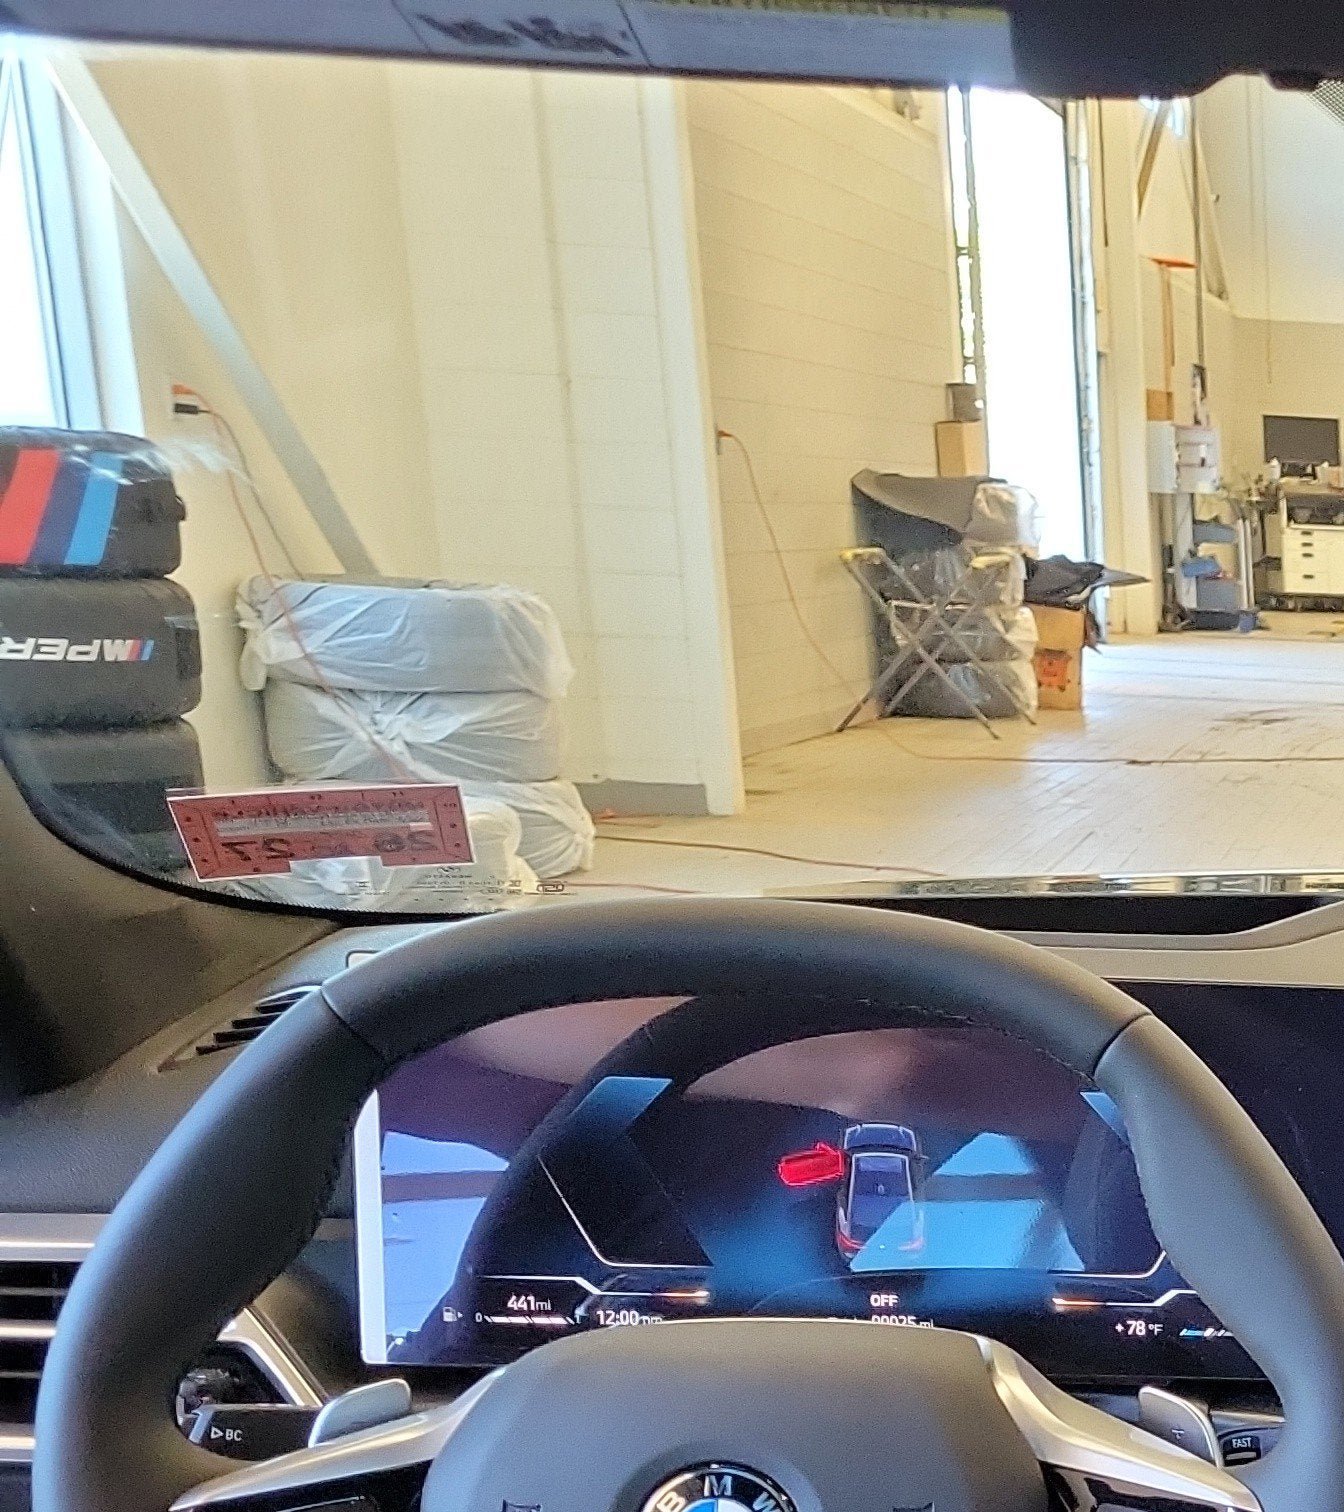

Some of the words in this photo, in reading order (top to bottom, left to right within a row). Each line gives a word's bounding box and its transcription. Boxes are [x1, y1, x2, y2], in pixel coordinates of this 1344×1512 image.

[870, 1294, 899, 1307] OFF
[225, 1429, 243, 1442] BC
[1231, 1436, 1252, 1449] FAST
